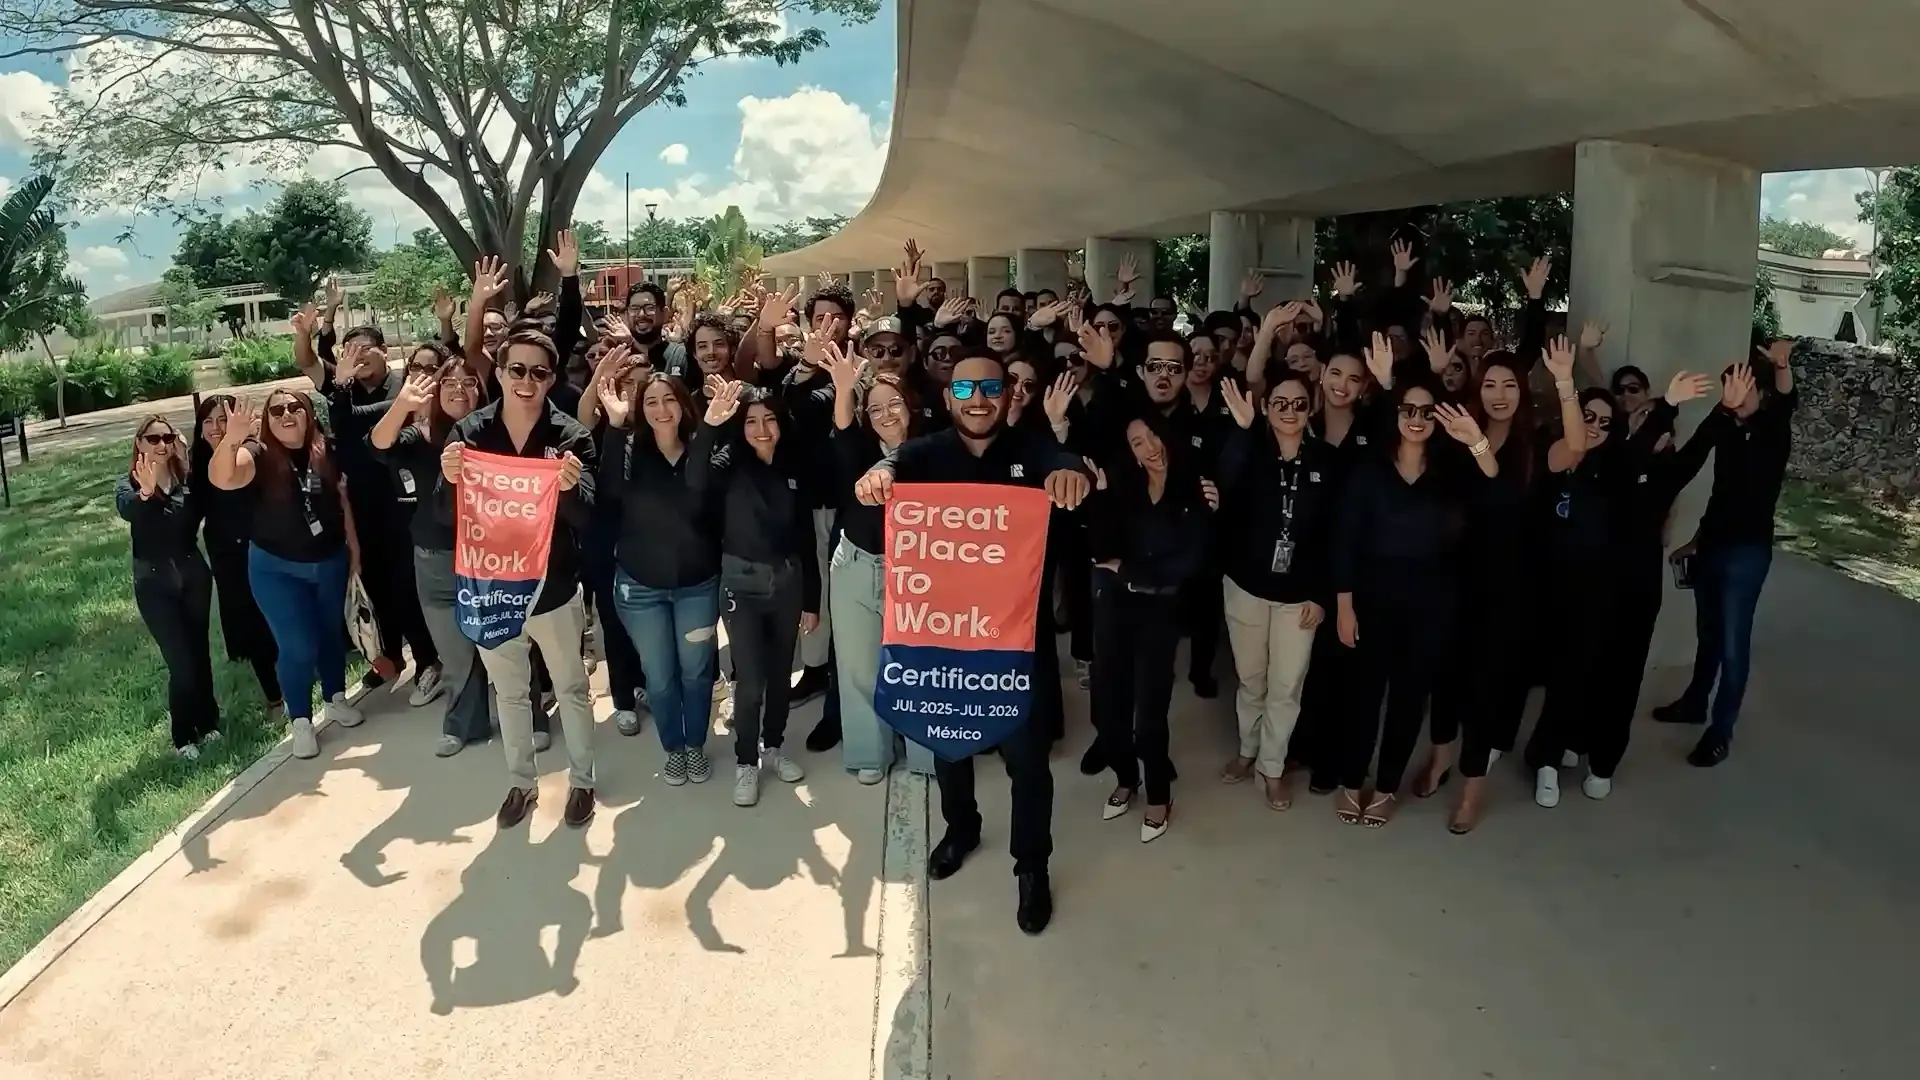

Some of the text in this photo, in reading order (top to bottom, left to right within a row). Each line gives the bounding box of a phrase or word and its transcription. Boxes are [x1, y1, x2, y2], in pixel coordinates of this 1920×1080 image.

[462, 461, 542, 495] Great
[463, 490, 538, 520] Place
[893, 500, 1010, 532] Great
[462, 514, 486, 541] To
[894, 530, 1006, 564] Place
[891, 565, 932, 596] To
[457, 588, 535, 608] Certificad
[464, 615, 481, 626] JUL
[484, 626, 510, 640] México
[883, 662, 1031, 692] Certificada
[891, 698, 917, 713] JUL
[989, 704, 1020, 717] 2026
[927, 725, 982, 741] México
